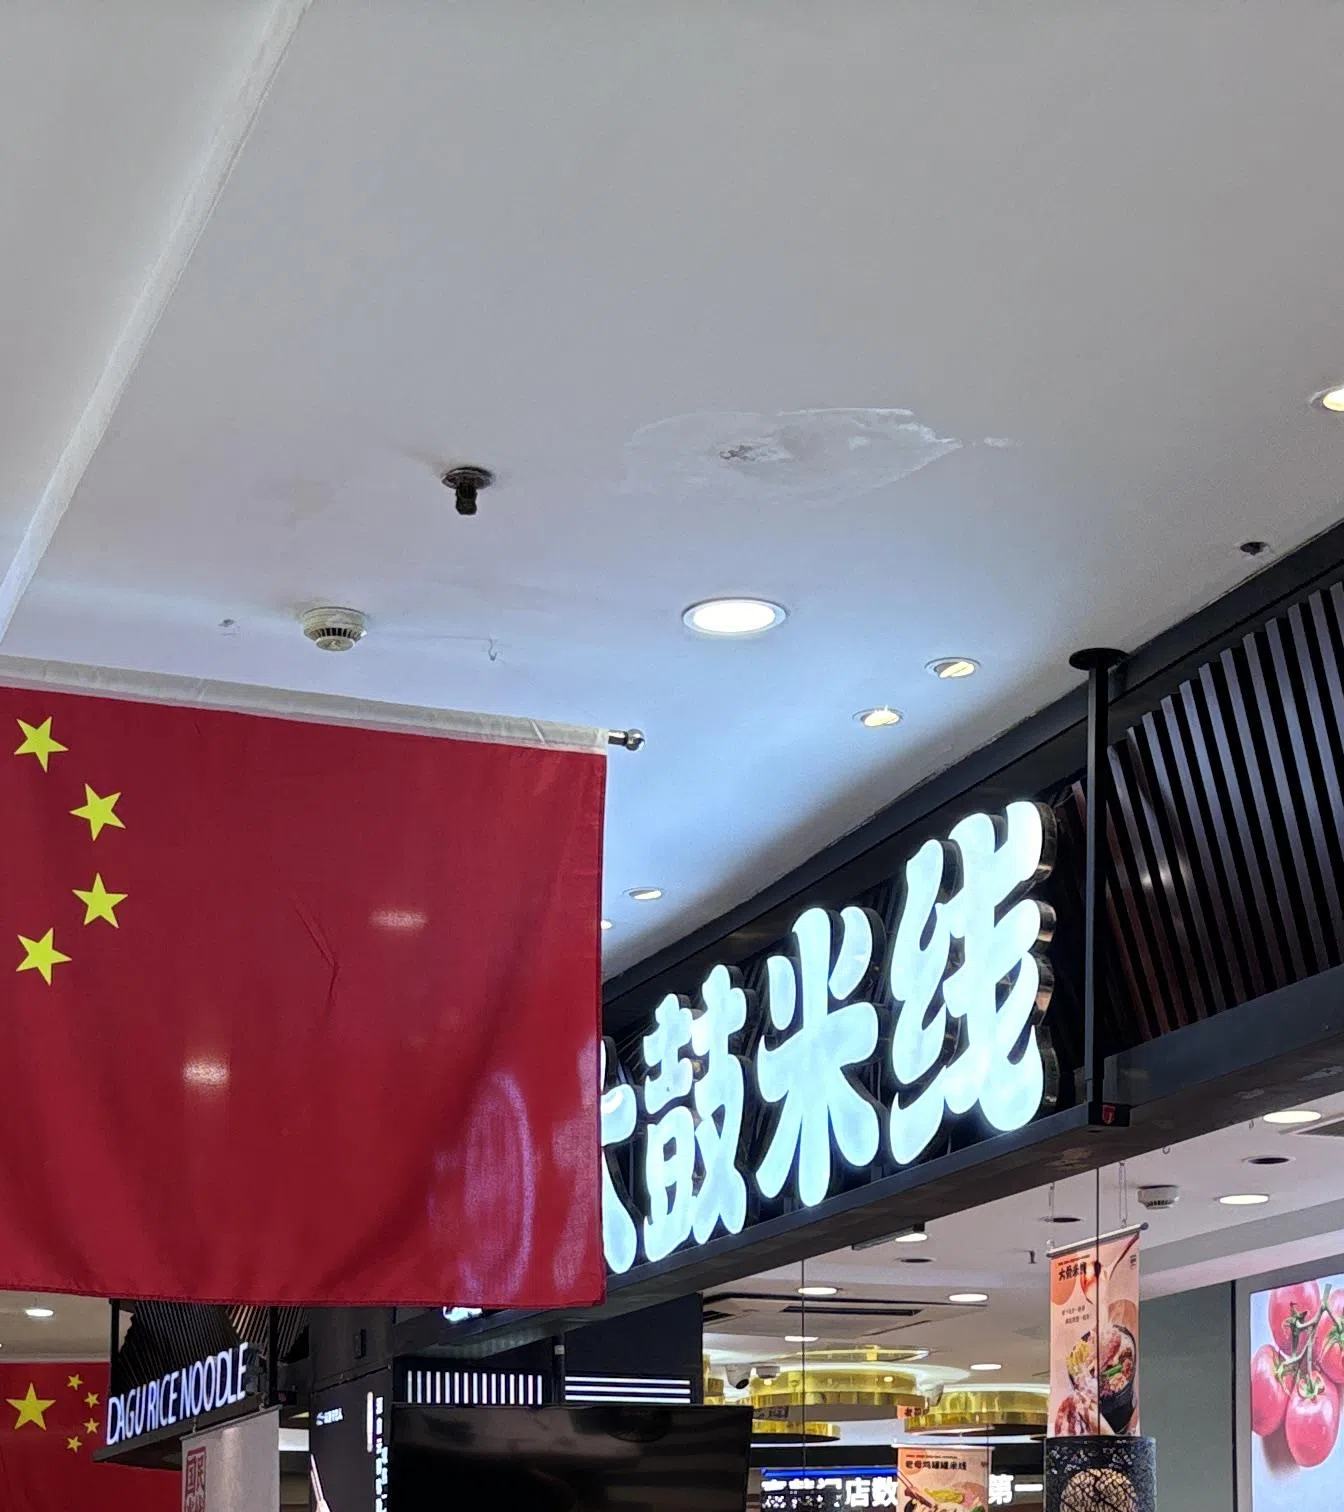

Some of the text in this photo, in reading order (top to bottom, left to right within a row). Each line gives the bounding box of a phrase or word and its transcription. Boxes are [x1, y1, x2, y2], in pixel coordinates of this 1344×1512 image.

[106, 1342, 248, 1445] DAGU RICE NOODLE
